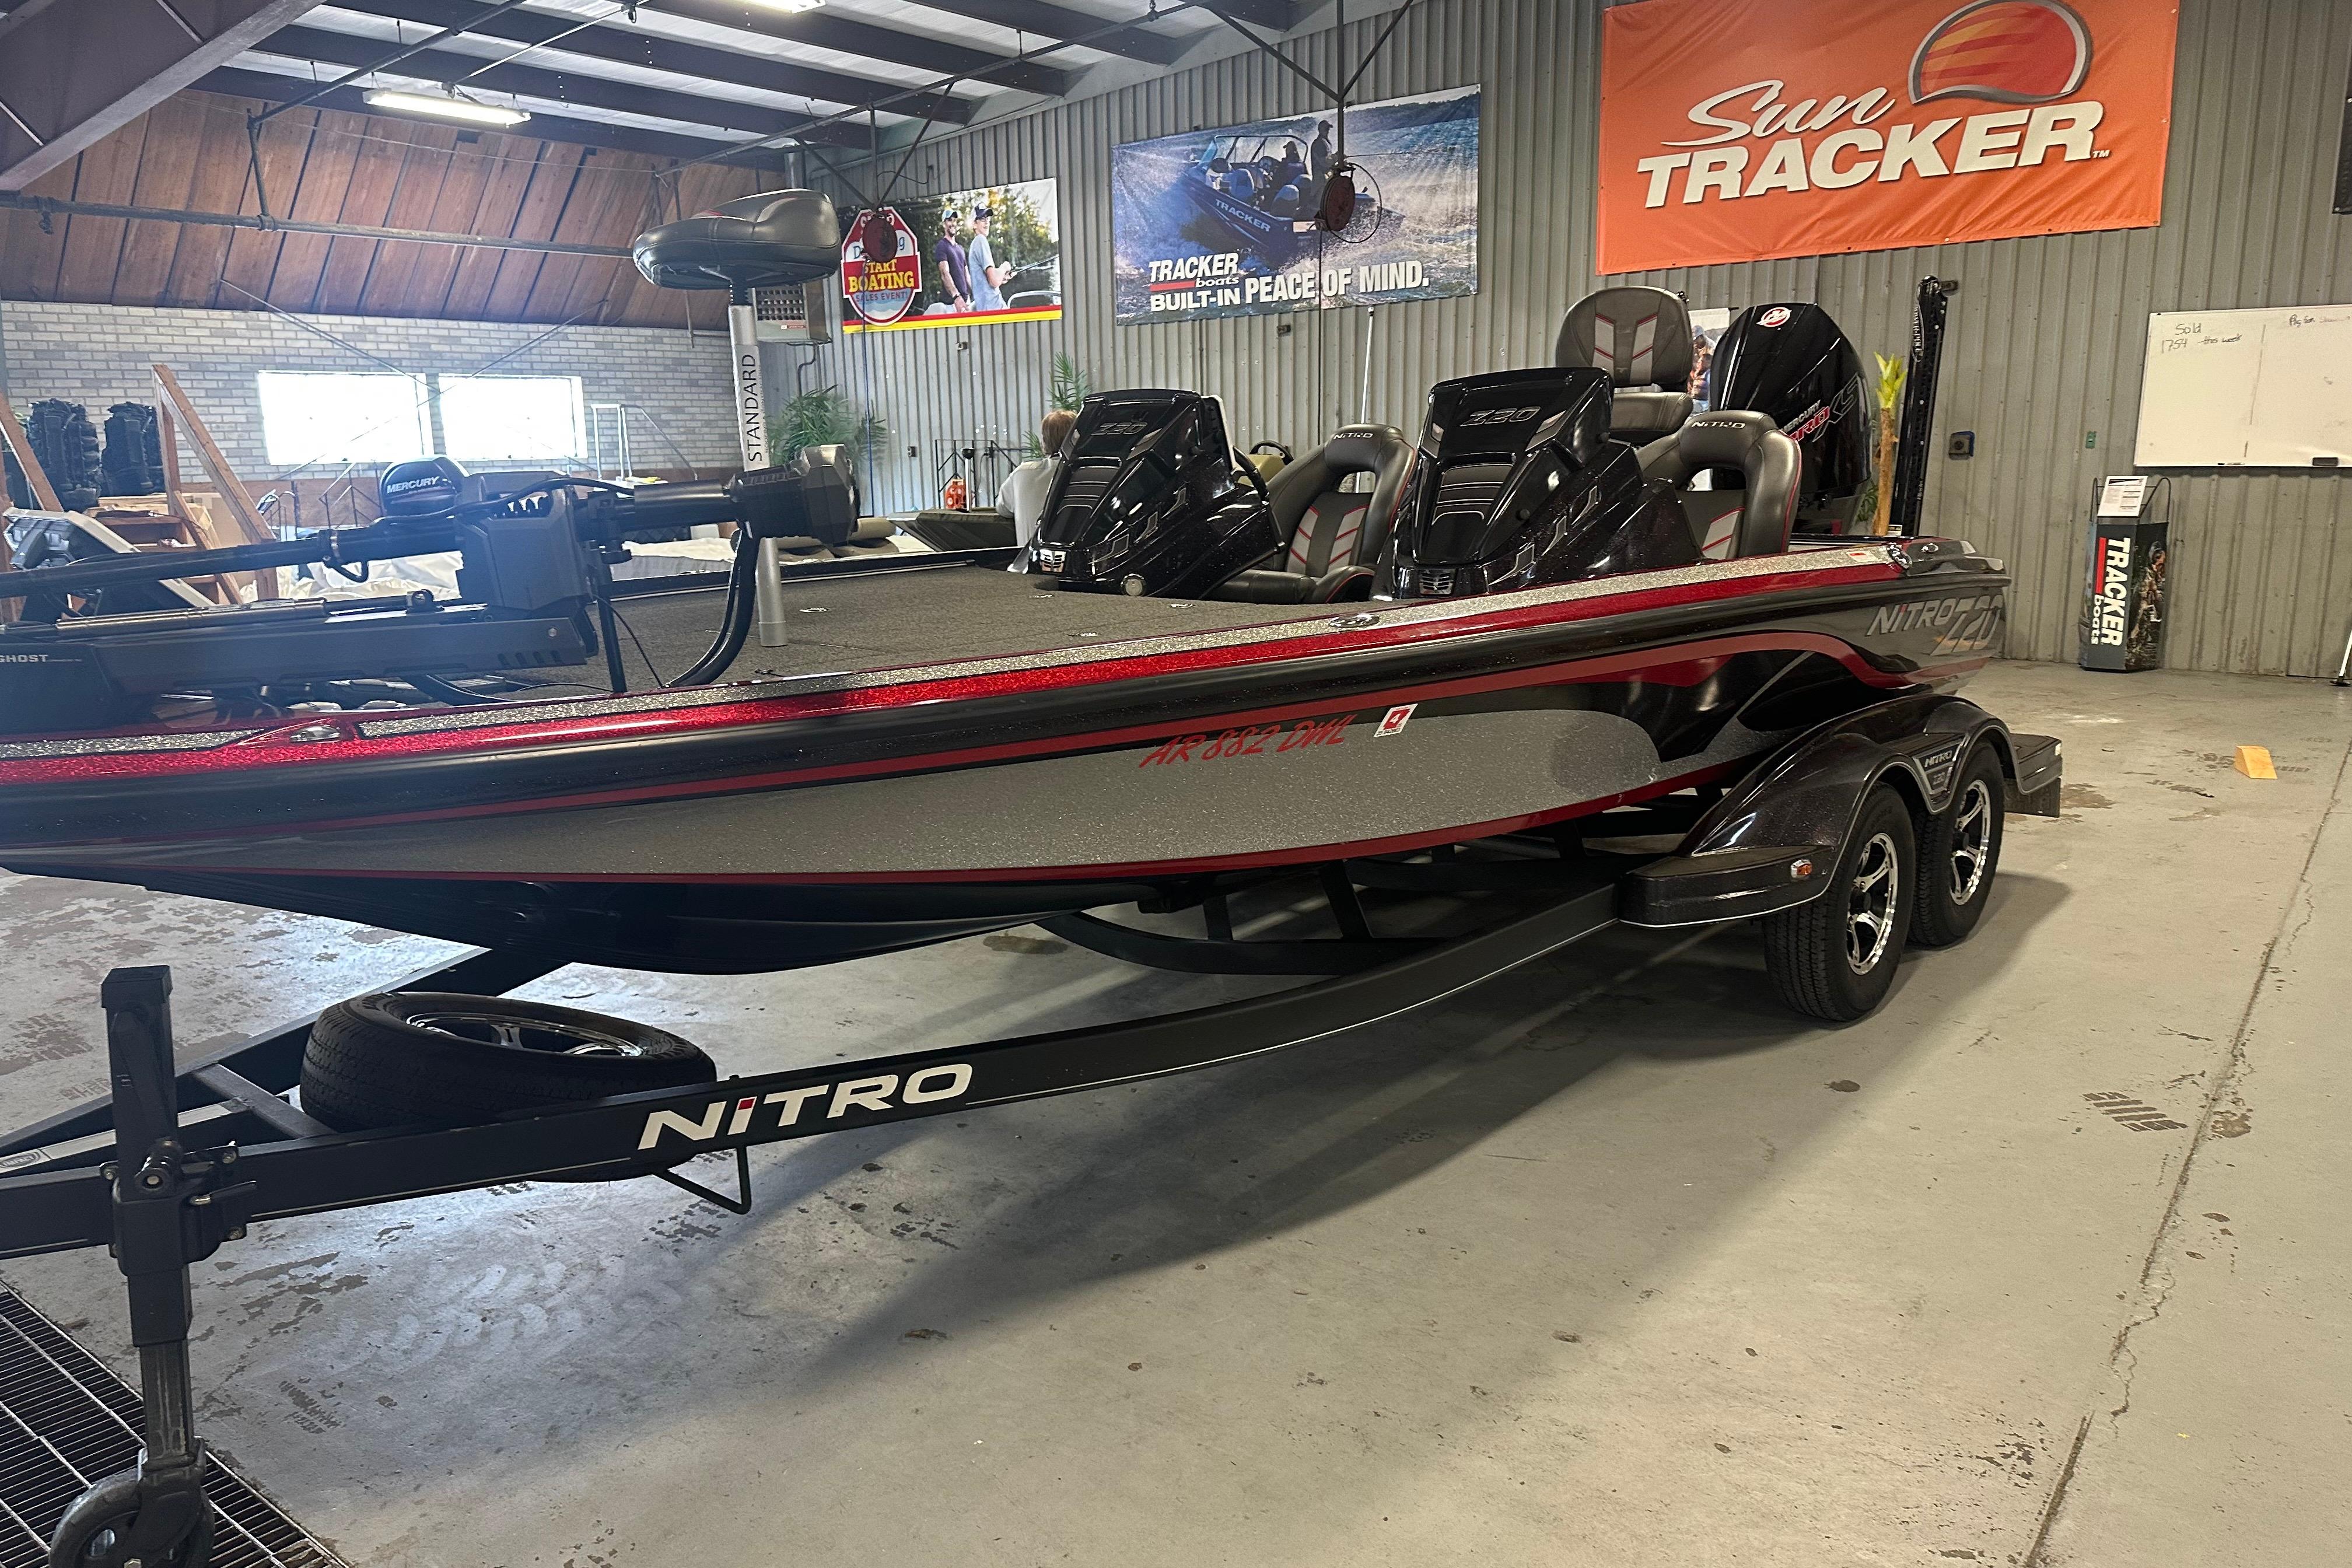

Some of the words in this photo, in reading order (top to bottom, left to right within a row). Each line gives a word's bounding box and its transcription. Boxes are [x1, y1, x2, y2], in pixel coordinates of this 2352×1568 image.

[1660, 79, 1895, 146] Sun
[1637, 101, 2104, 208] TRACKER
[1214, 198, 1270, 232] TRACKER
[848, 271, 915, 292] BOATING
[1148, 252, 1239, 282] TRACKER
[1150, 287, 1241, 312] BUILT-IN
[1245, 274, 1316, 304] PEACE
[1324, 268, 1352, 297] OF
[1359, 260, 1430, 293] MIND.
[1195, 275, 1240, 287] boats
[2175, 323, 2202, 335] Sold
[741, 354, 762, 461] STANDARD
[1460, 407, 1541, 427] Z20
[387, 476, 440, 494] MERCURY
[2100, 537, 2132, 647] TRACKER
[1866, 598, 1957, 636] NITRO
[2091, 594, 2105, 645] boats
[1139, 735, 1206, 768] AR
[1201, 724, 1280, 761] 882
[1924, 750, 1952, 767] NITRO
[638, 1063, 973, 1150] NITRO
